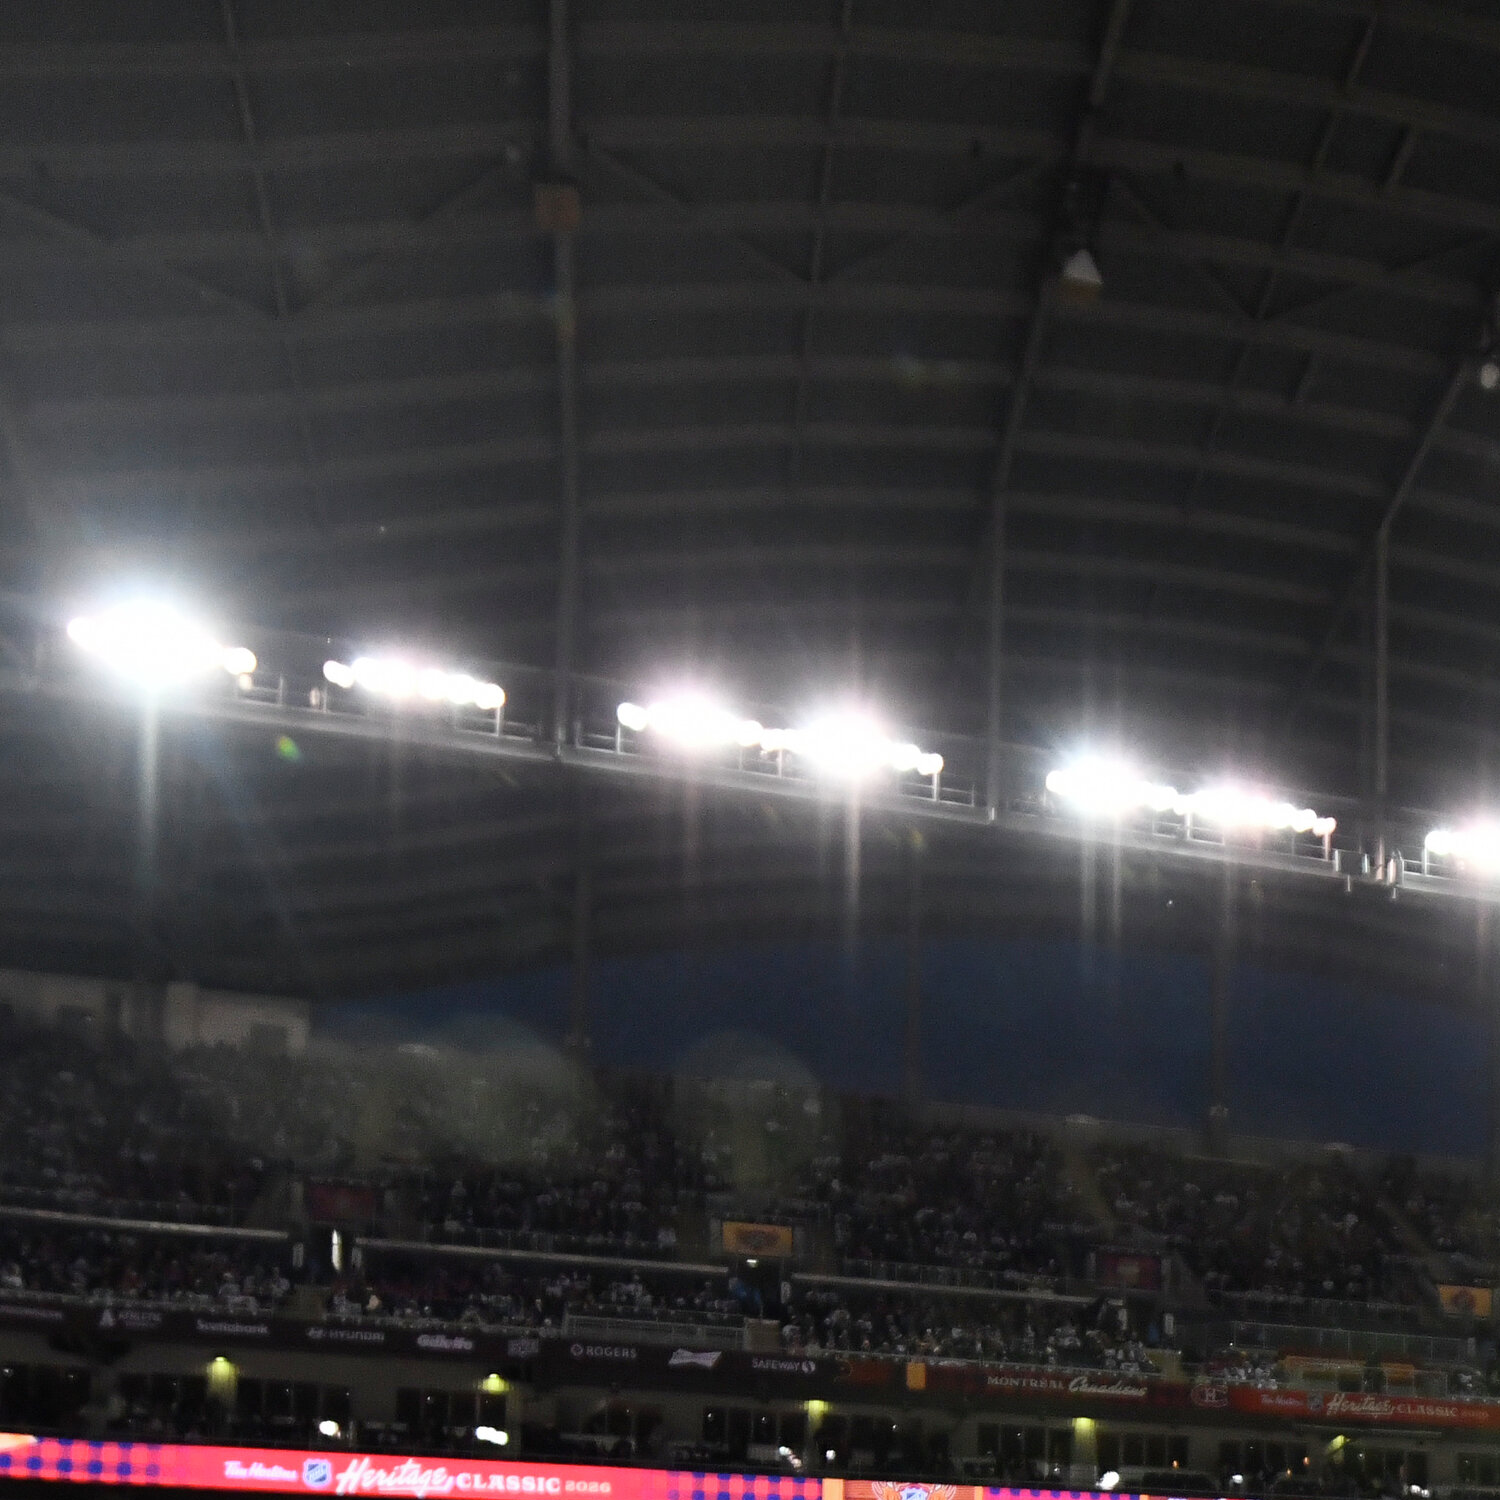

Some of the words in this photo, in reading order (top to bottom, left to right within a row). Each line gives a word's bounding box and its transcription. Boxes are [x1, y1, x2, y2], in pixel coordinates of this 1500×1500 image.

[196, 1319, 270, 1336] Scotiabank
[329, 1330, 385, 1342] HYUNDAI
[416, 1334, 475, 1351] Gillette
[585, 1346, 637, 1359] ROGERS
[752, 1358, 800, 1371] SAFEWAY
[1397, 1403, 1459, 1418] CLASSIC
[224, 1459, 246, 1480] Tim
[336, 1457, 453, 1497] Heritage
[456, 1472, 561, 1494] CLASSIC
[565, 1479, 612, 1495] 2026
